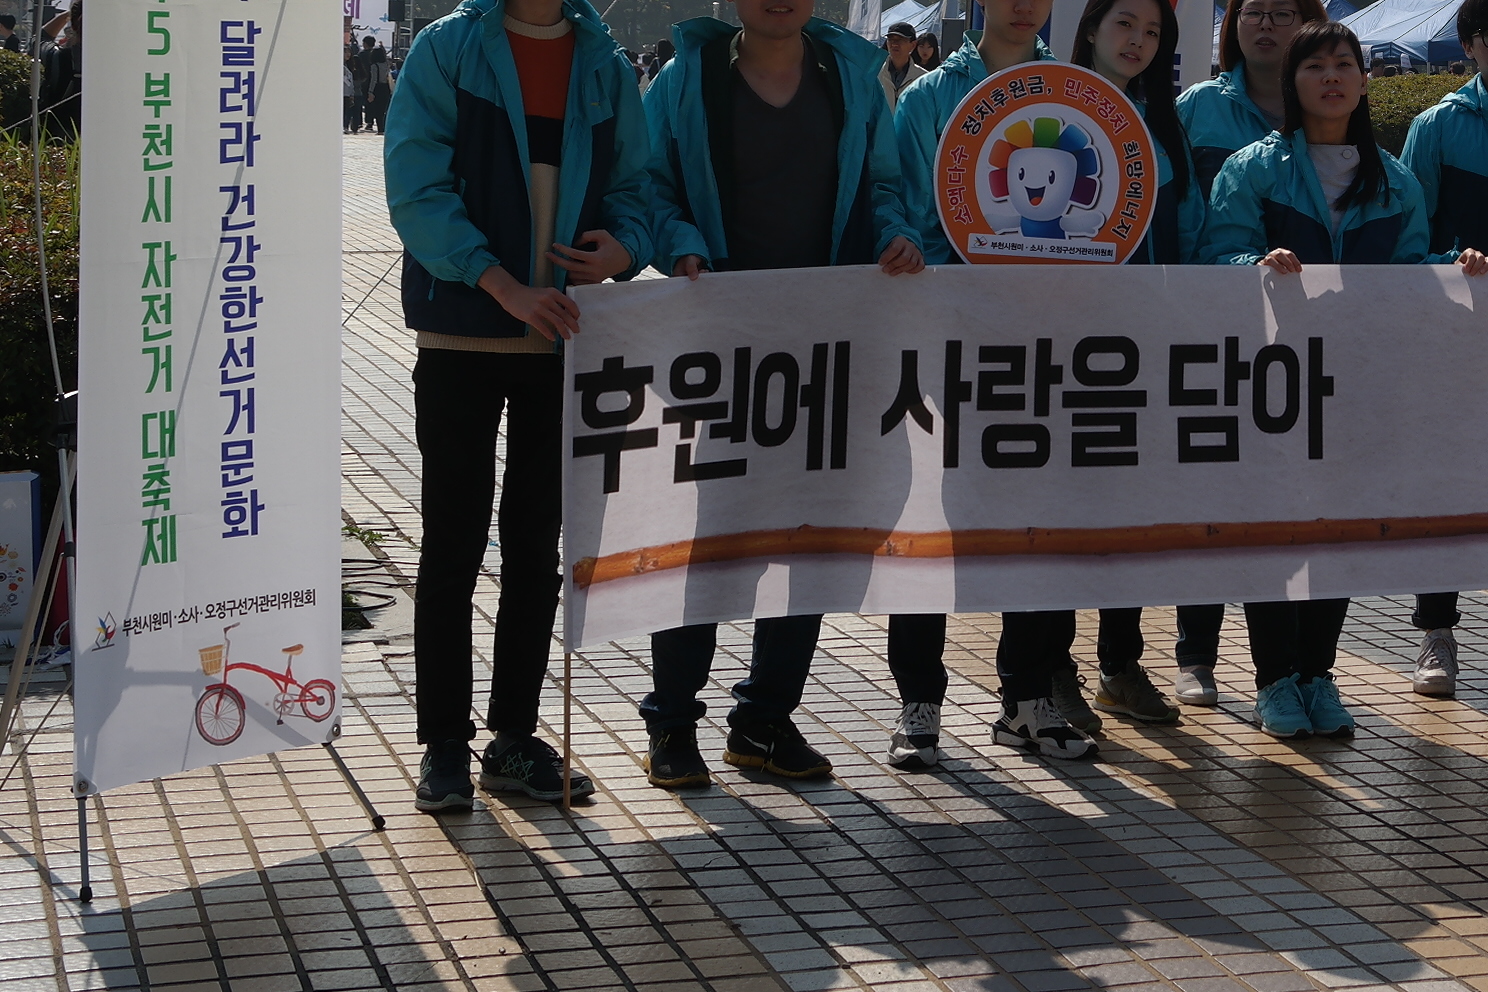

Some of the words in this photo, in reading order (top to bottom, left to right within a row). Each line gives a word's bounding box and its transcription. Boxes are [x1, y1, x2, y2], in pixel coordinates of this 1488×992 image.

[141, 71, 173, 224] 부천시
[219, 20, 262, 168] 달려라
[947, 144, 973, 226] 소액다수
[1063, 77, 1130, 135] 민주정치
[1111, 140, 1146, 240] 희망에너지
[141, 241, 177, 394] 자전거
[141, 409, 178, 567] 대축제
[572, 339, 850, 494] 후원에
[880, 335, 1147, 469] 사랑을
[1168, 335, 1335, 464] 담아
